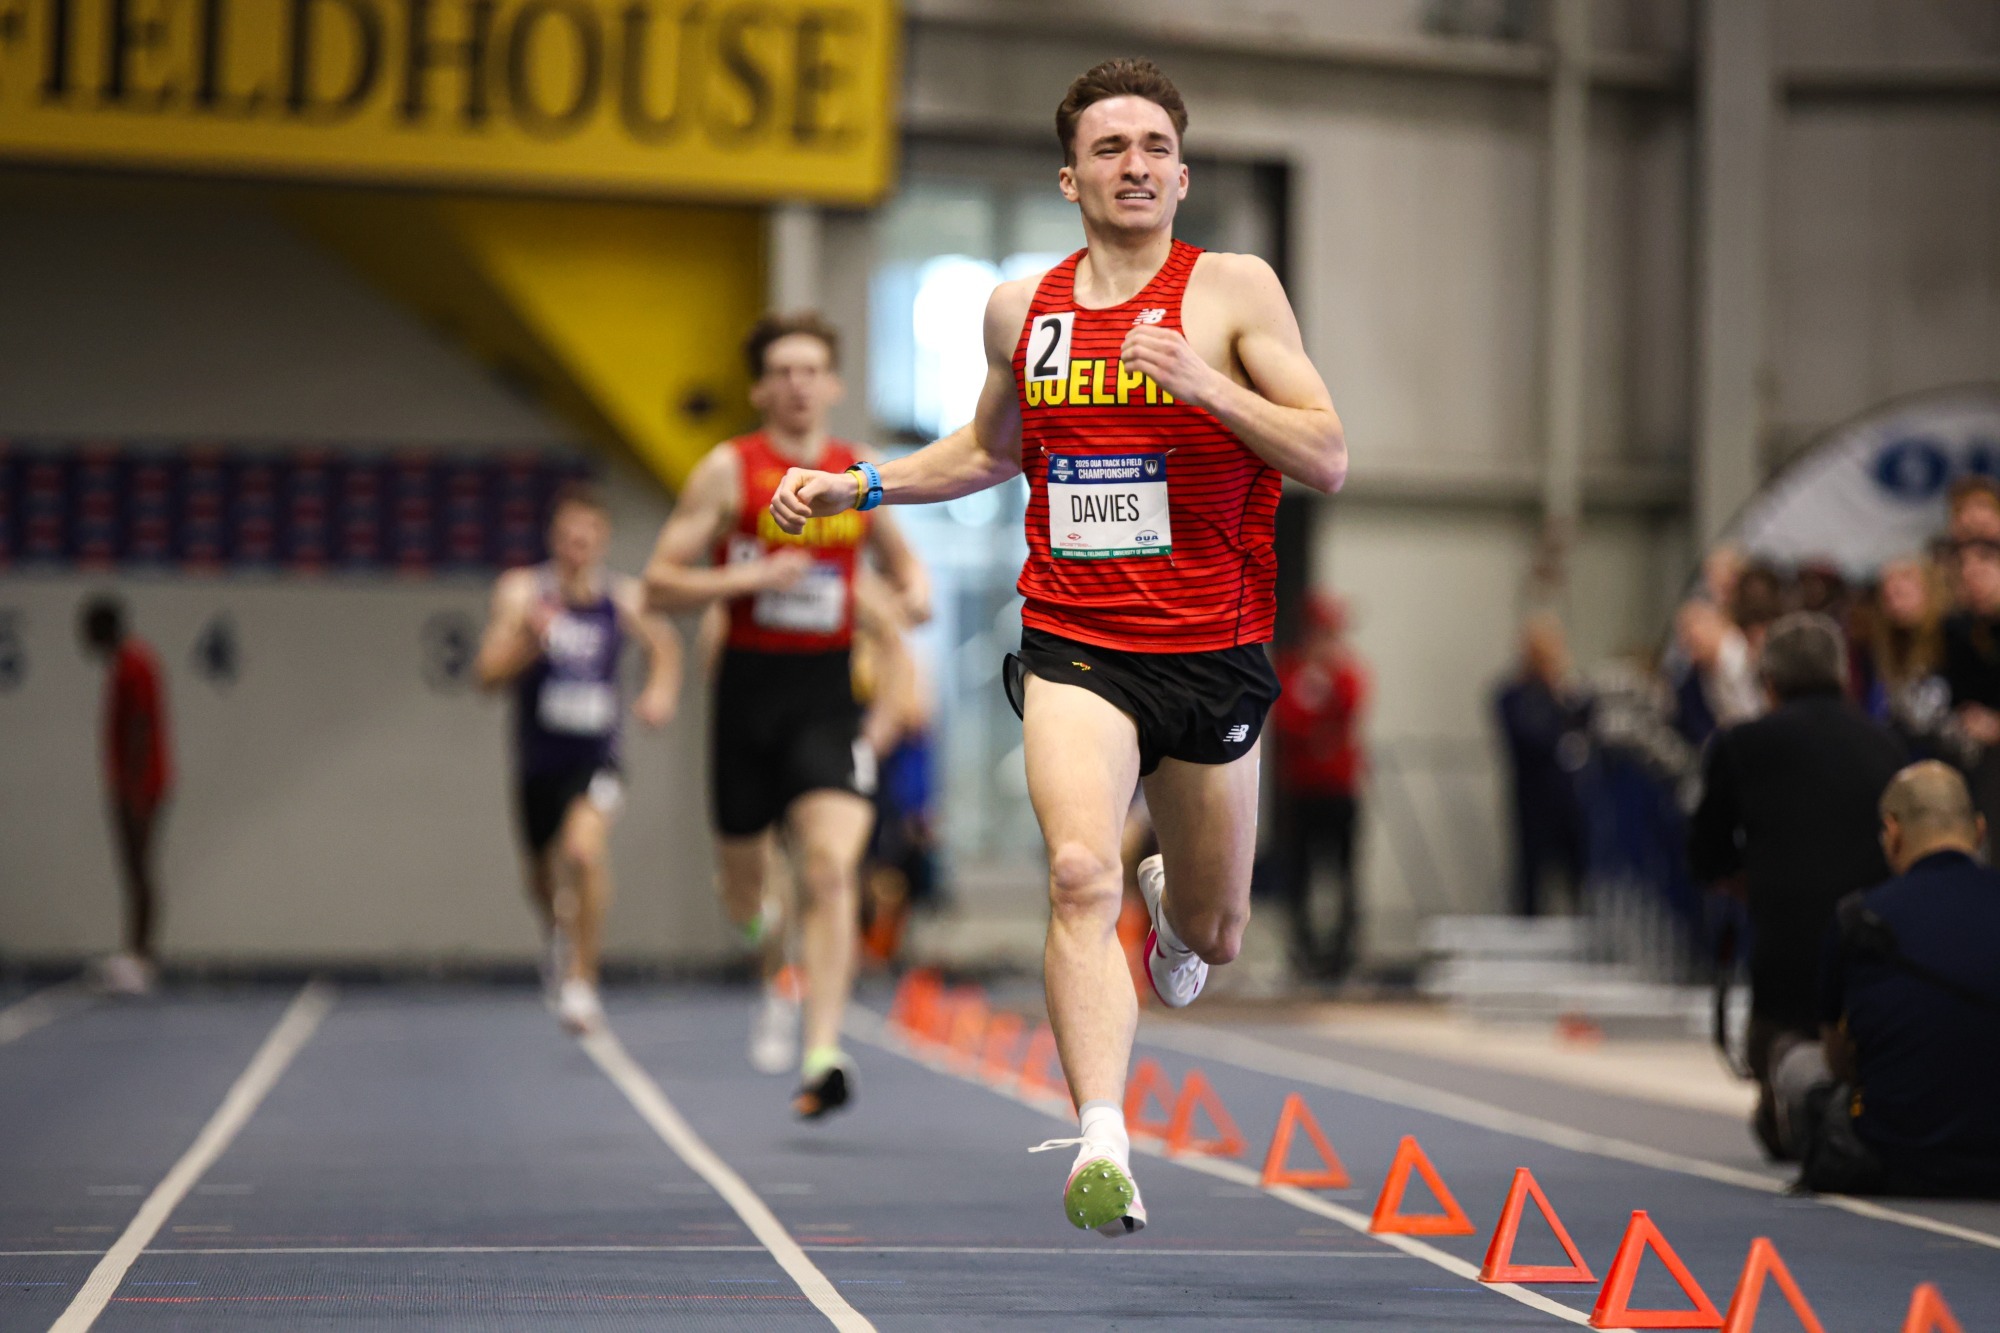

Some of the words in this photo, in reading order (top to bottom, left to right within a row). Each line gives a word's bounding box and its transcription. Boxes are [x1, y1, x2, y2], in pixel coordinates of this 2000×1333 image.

[0, 0, 865, 152] IELDHOUSE
[1034, 318, 1063, 377] 2
[1075, 460, 1090, 468] 2025
[1090, 459, 1102, 467] OUA
[1102, 459, 1121, 467] TRACK
[1126, 458, 1142, 466] FIELD
[1078, 467, 1140, 479] CHAMPIONSHIPS
[1071, 493, 1140, 523] DAVIES
